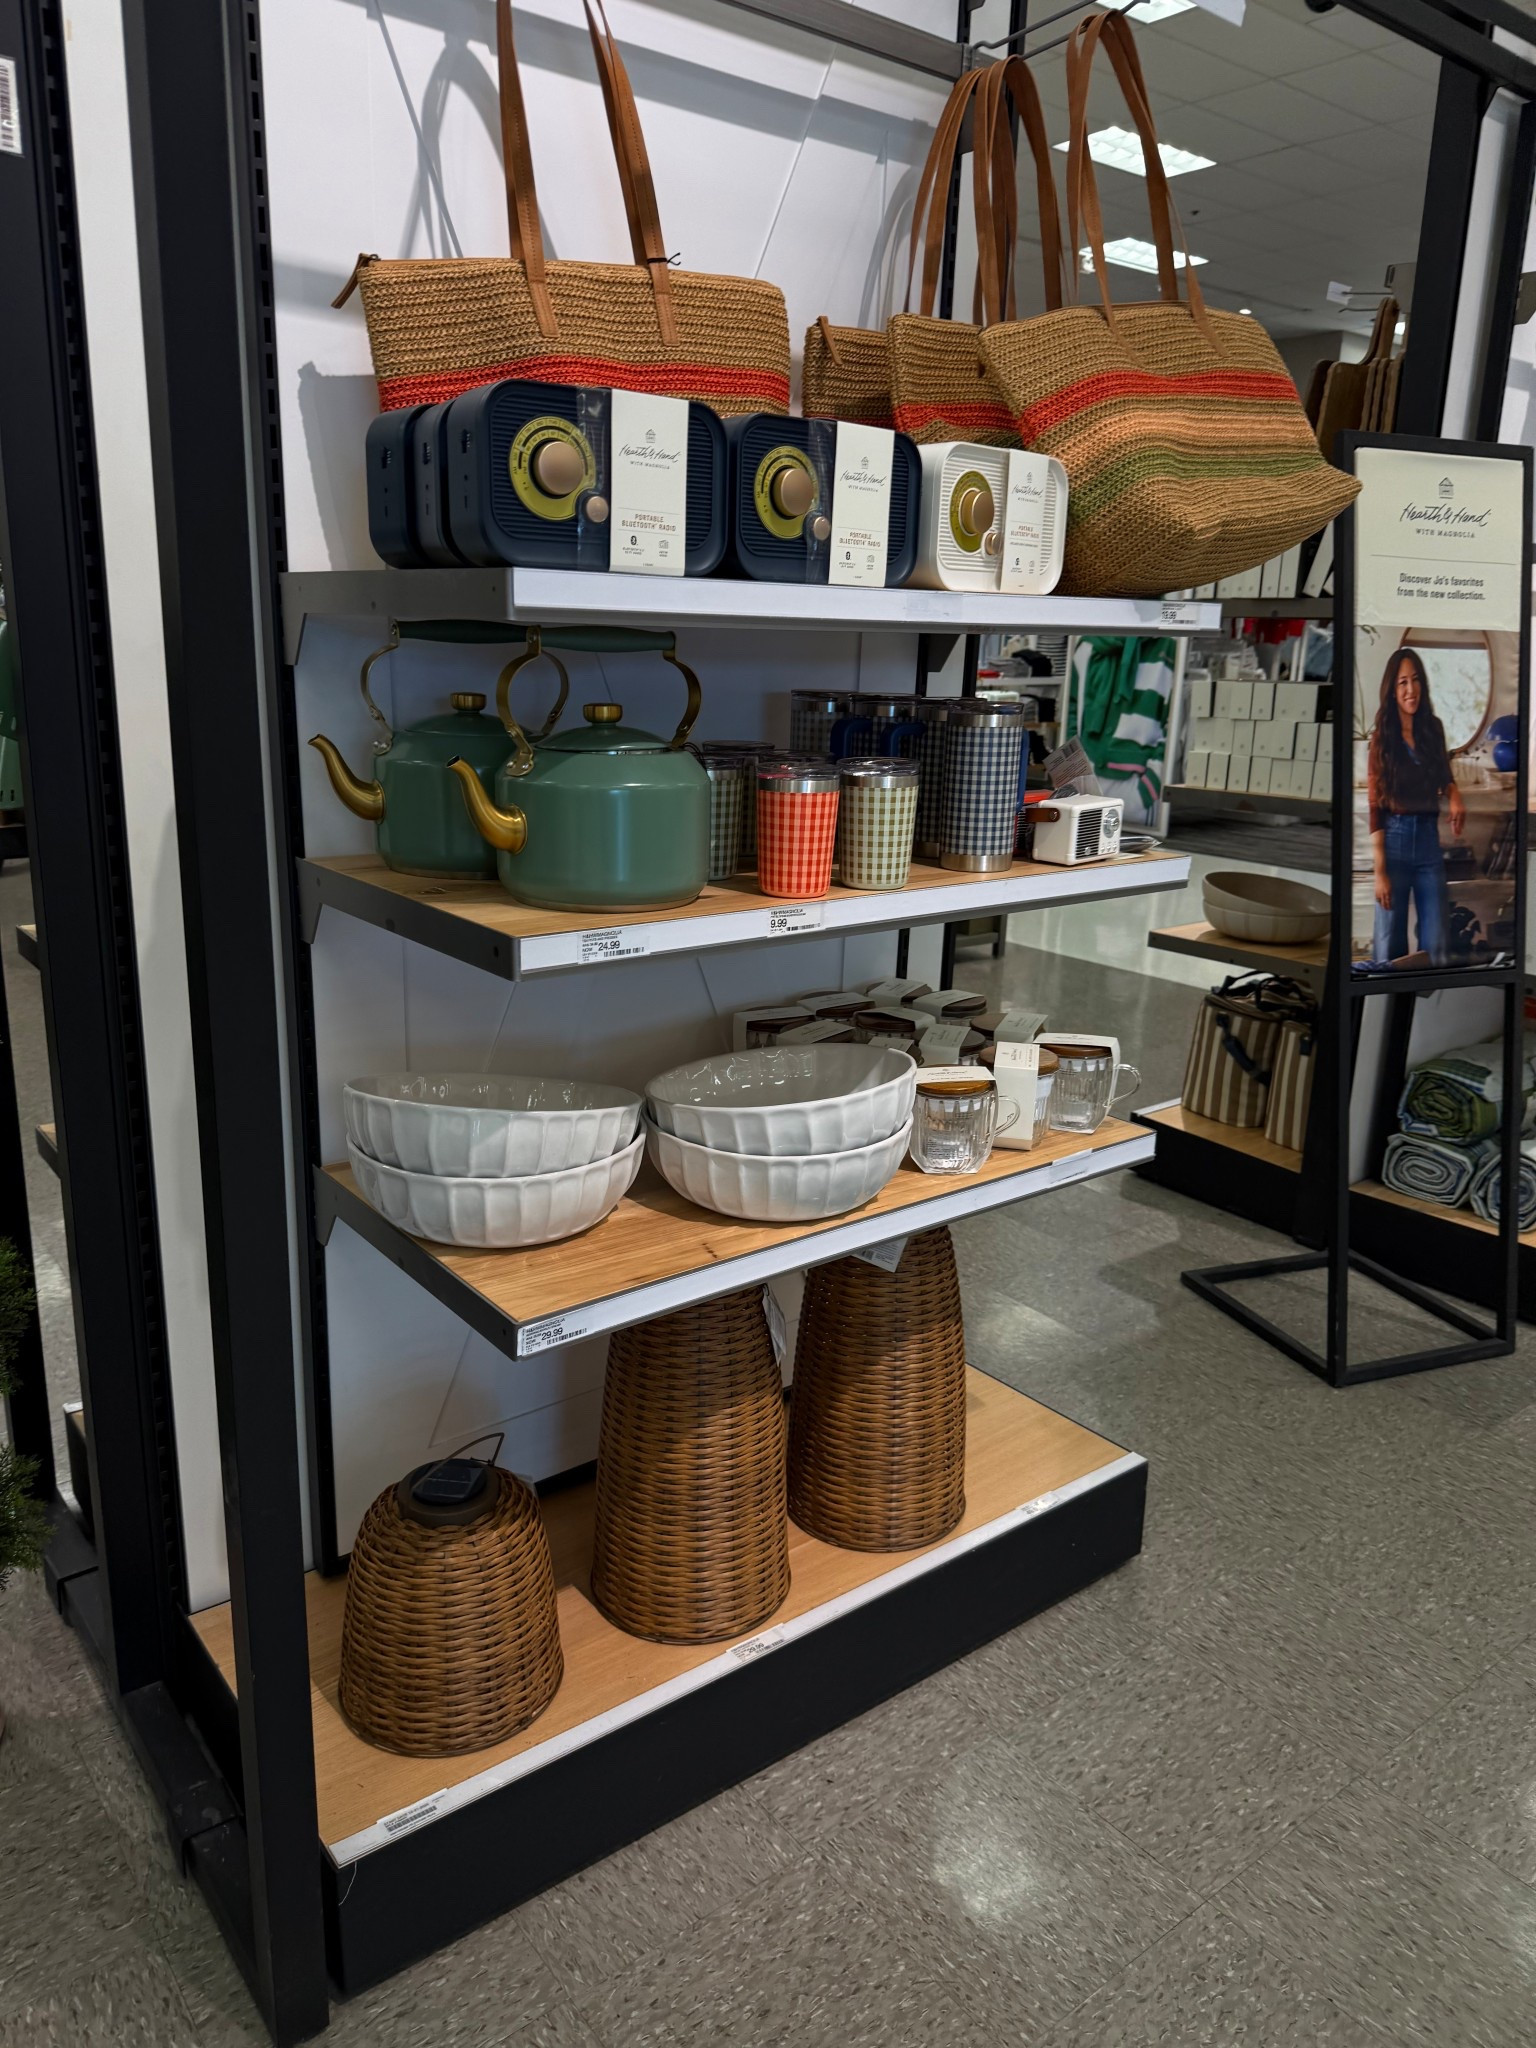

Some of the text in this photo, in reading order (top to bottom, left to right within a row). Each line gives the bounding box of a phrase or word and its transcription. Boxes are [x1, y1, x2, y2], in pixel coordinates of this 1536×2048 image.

[635, 513, 664, 522] PORTABLE
[1400, 502, 1446, 523] Hearth
[1451, 507, 1491, 527] Hand
[659, 524, 676, 532] RADIO
[1416, 528, 1475, 538] WITH MAGNOLIA
[1400, 573, 1484, 587] Discover Jo's favorites
[1397, 586, 1486, 600] from the new collection.
[770, 918, 787, 928] 9.99
[598, 940, 620, 951] 24.99
[541, 1327, 563, 1340] 29.99
